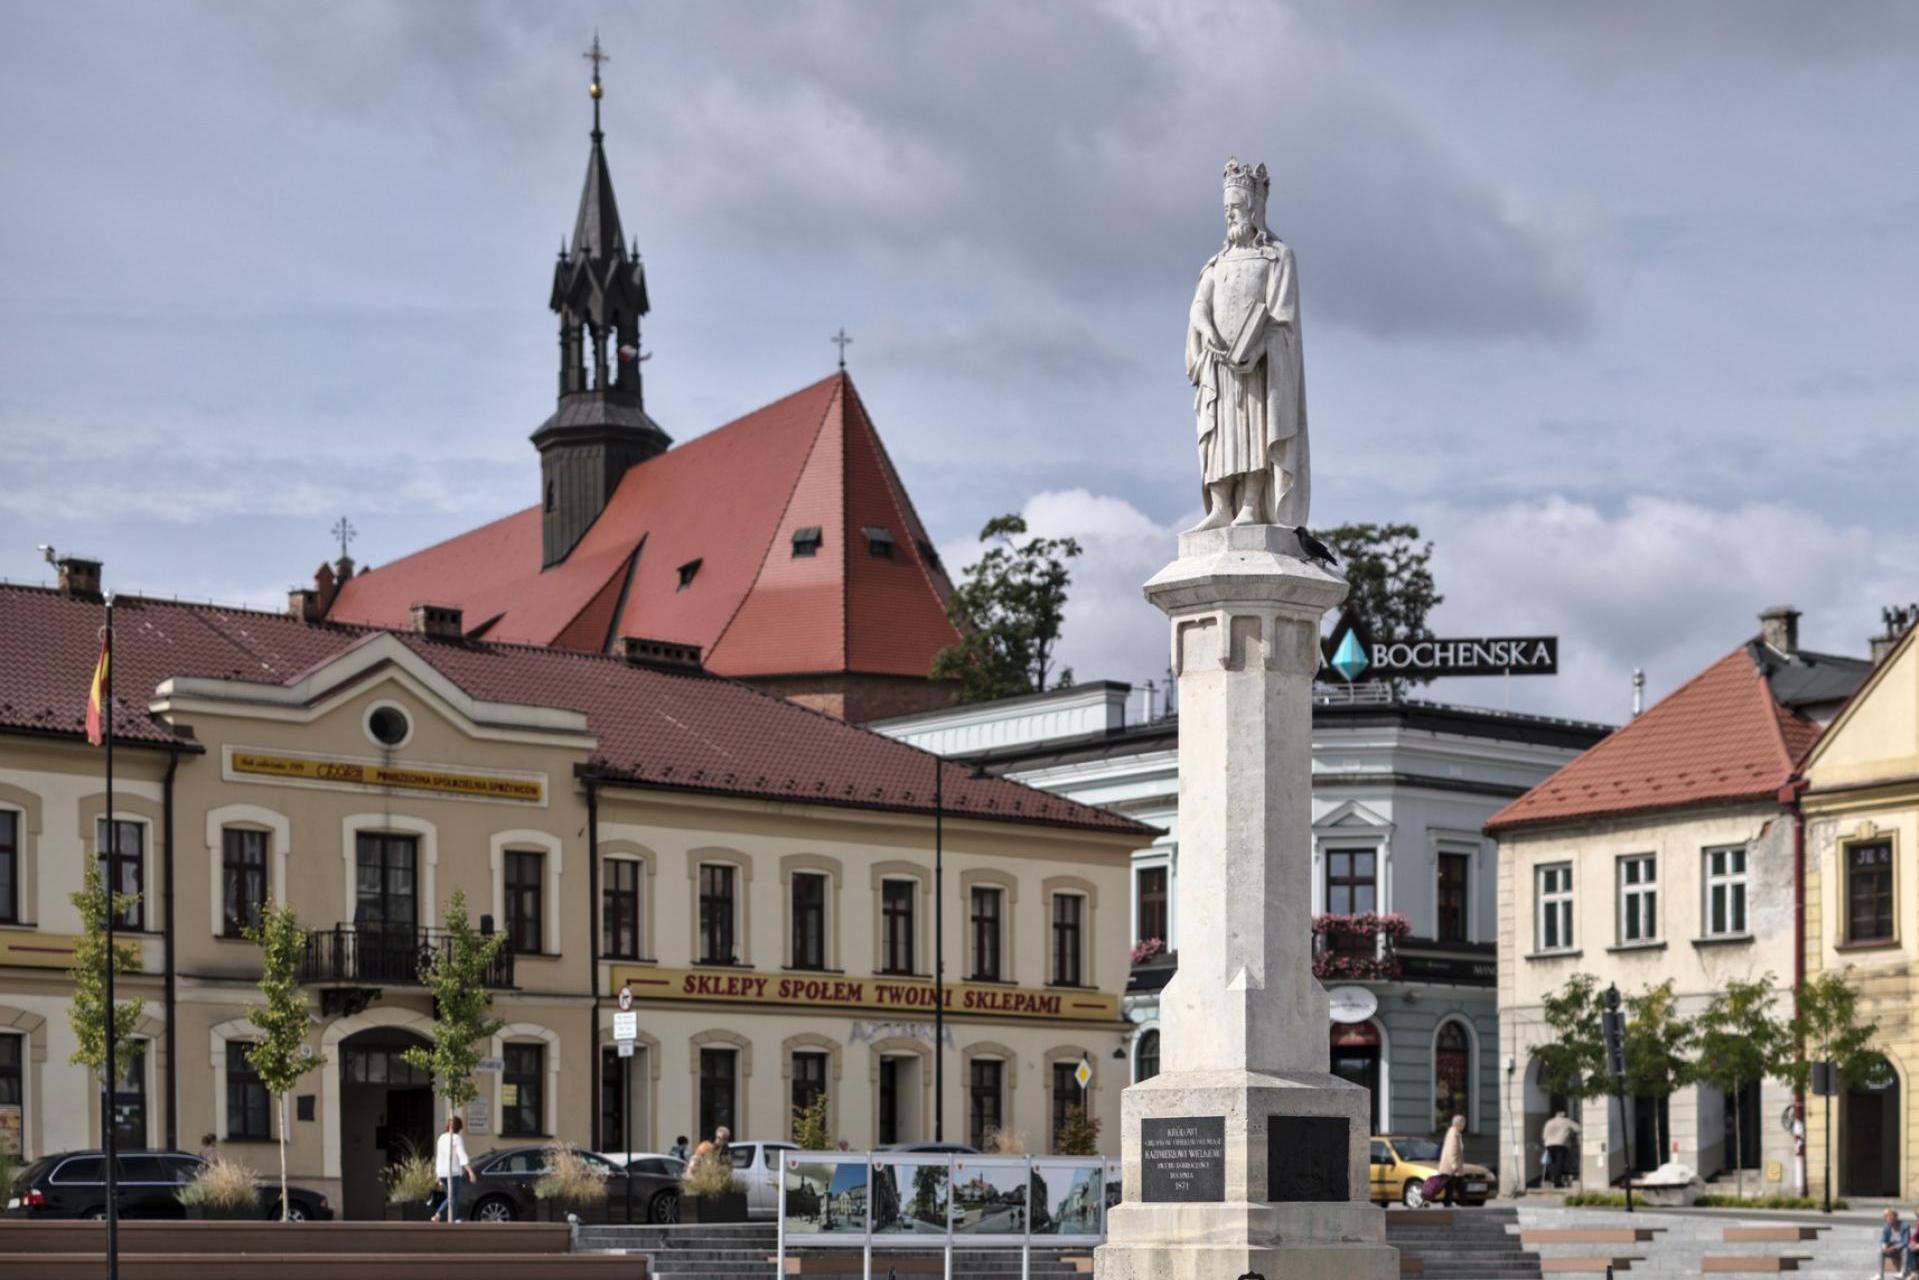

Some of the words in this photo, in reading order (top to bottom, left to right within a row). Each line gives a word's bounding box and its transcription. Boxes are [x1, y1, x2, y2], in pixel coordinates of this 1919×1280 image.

[1372, 637, 1552, 668] BOCHEŃSKA
[683, 974, 768, 998] SKLEPY
[778, 979, 864, 1001] SPOŁEM
[963, 990, 1062, 1013] SKLEPAMI
